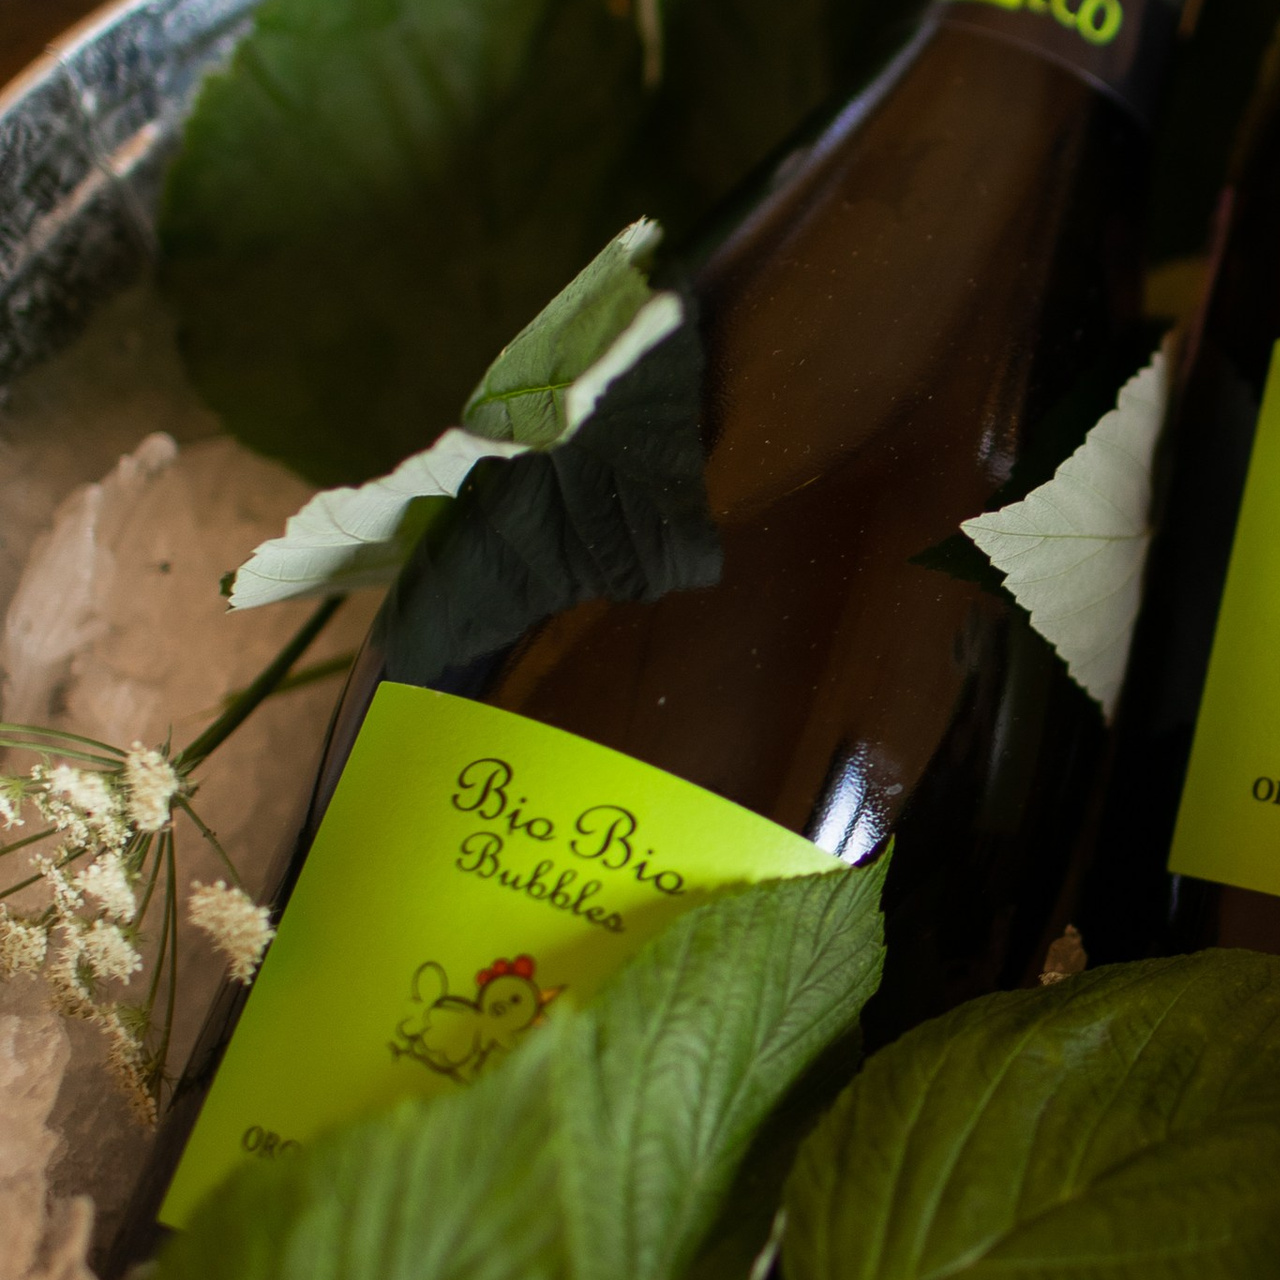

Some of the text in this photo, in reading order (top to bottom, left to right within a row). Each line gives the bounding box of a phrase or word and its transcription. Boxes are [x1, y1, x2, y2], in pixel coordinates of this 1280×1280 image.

[452, 757, 688, 896] Bio Bio
[456, 831, 626, 933] Bubbles
